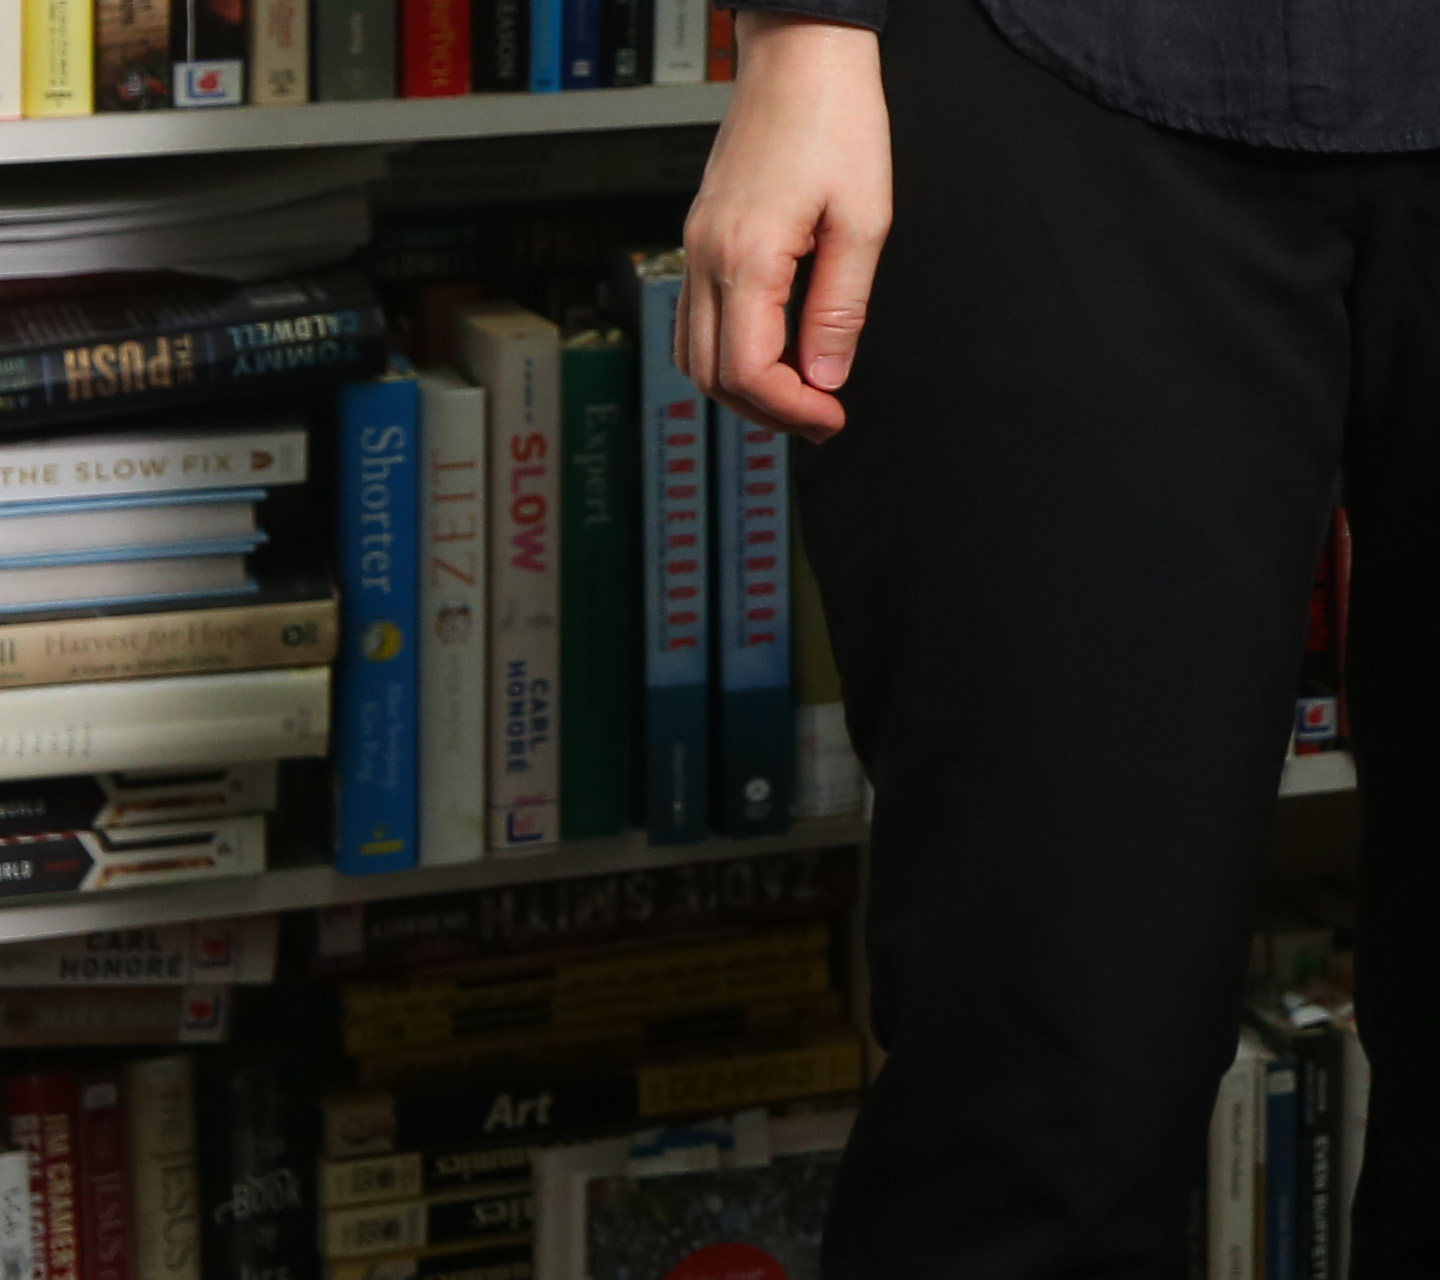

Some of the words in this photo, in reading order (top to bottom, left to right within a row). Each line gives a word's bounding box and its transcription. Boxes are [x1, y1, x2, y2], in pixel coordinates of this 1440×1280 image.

[228, 310, 360, 351] CALDWELL
[232, 337, 360, 378] TOMMY
[64, 337, 168, 401] PUSH
[0, 462, 52, 487] THE
[74, 455, 170, 485] SLOW
[180, 451, 234, 476] FIX
[574, 403, 617, 527] Expert
[356, 424, 404, 594] Shorter
[428, 447, 475, 588] ZEIT
[508, 432, 548, 574] SLOW
[666, 399, 698, 653] WONDERBOOK
[504, 660, 532, 776] HONORÉ
[529, 678, 549, 753] CARL
[87, 927, 162, 956] CARL
[483, 1090, 556, 1132] Art
